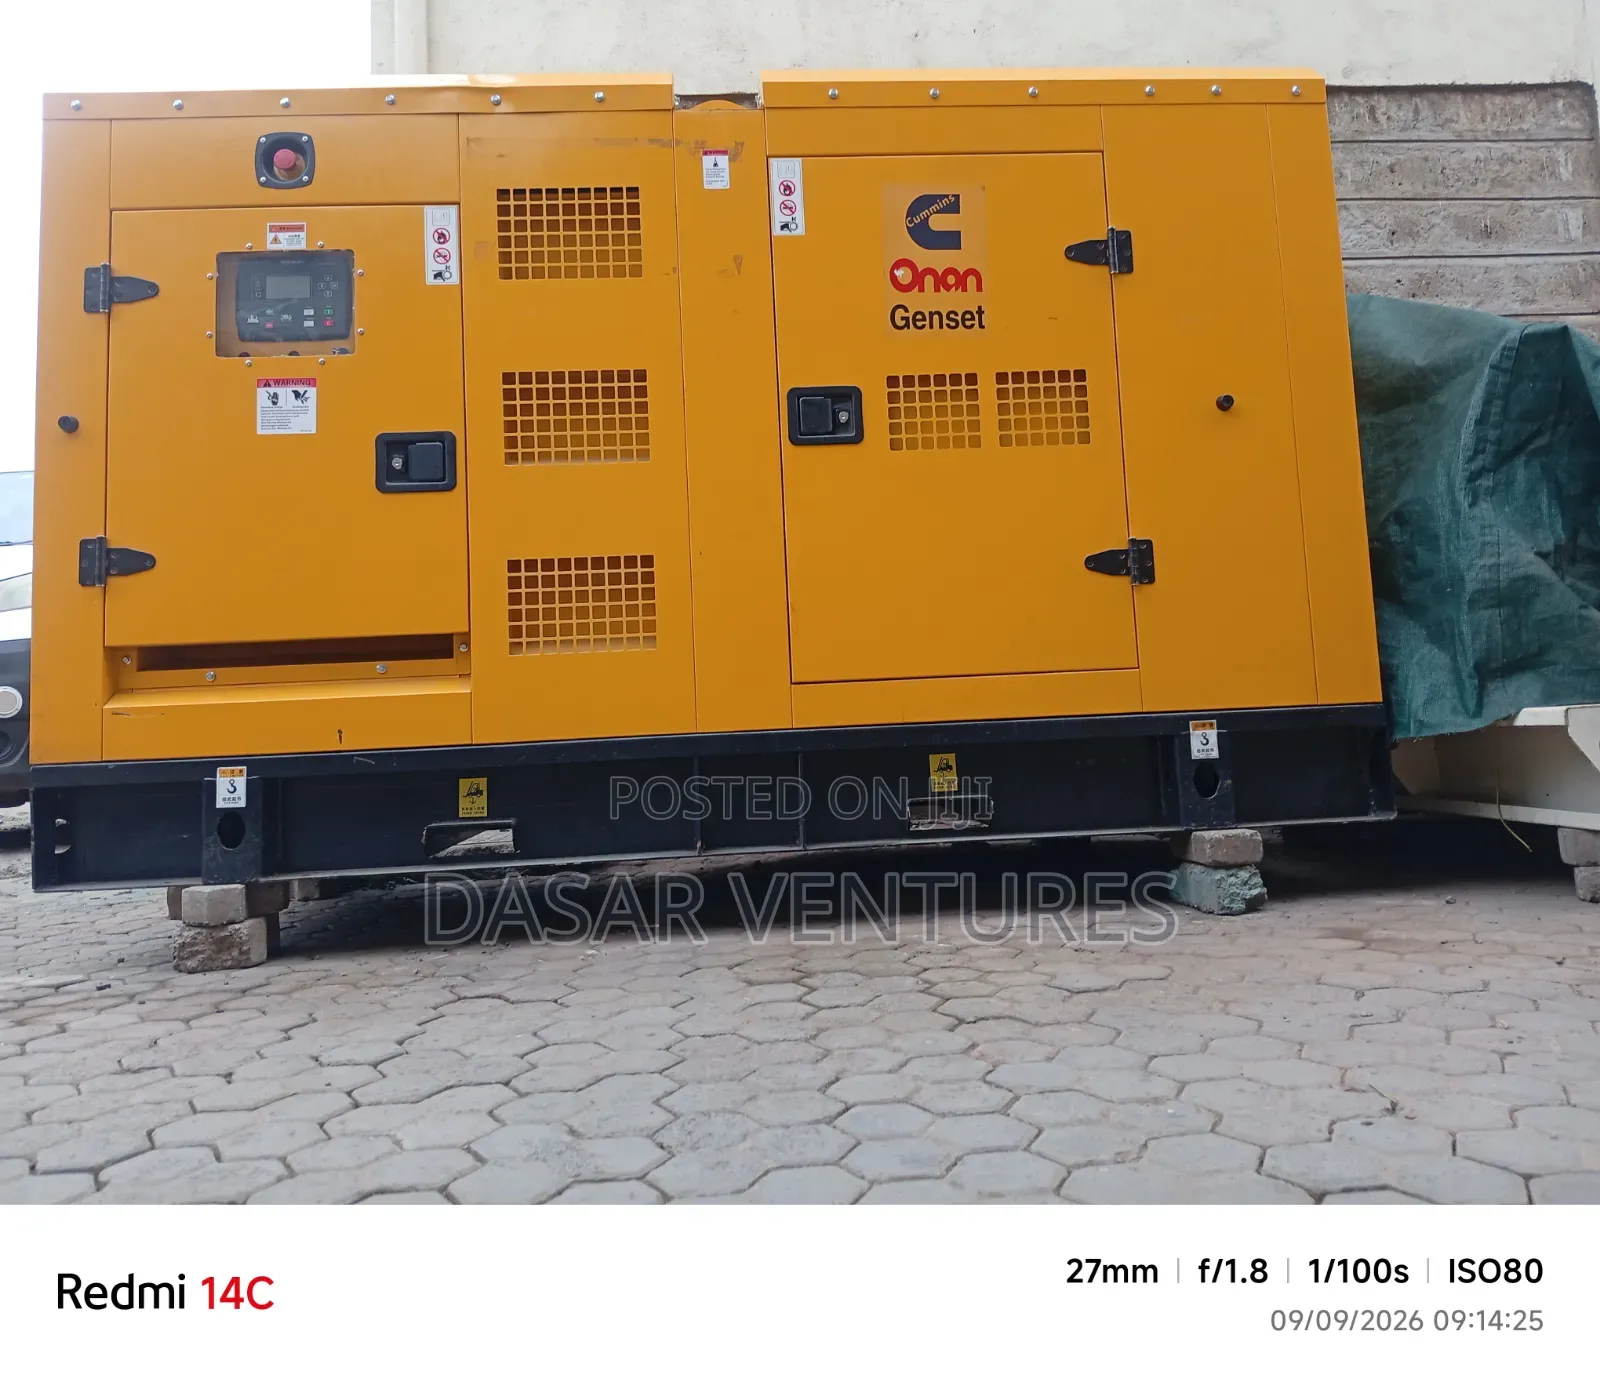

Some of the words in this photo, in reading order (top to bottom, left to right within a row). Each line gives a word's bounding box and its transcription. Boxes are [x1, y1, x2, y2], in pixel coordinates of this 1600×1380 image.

[906, 194, 955, 228] Cummins
[889, 258, 983, 293] Onan
[889, 303, 986, 331] Genset
[272, 379, 312, 387] WARNING
